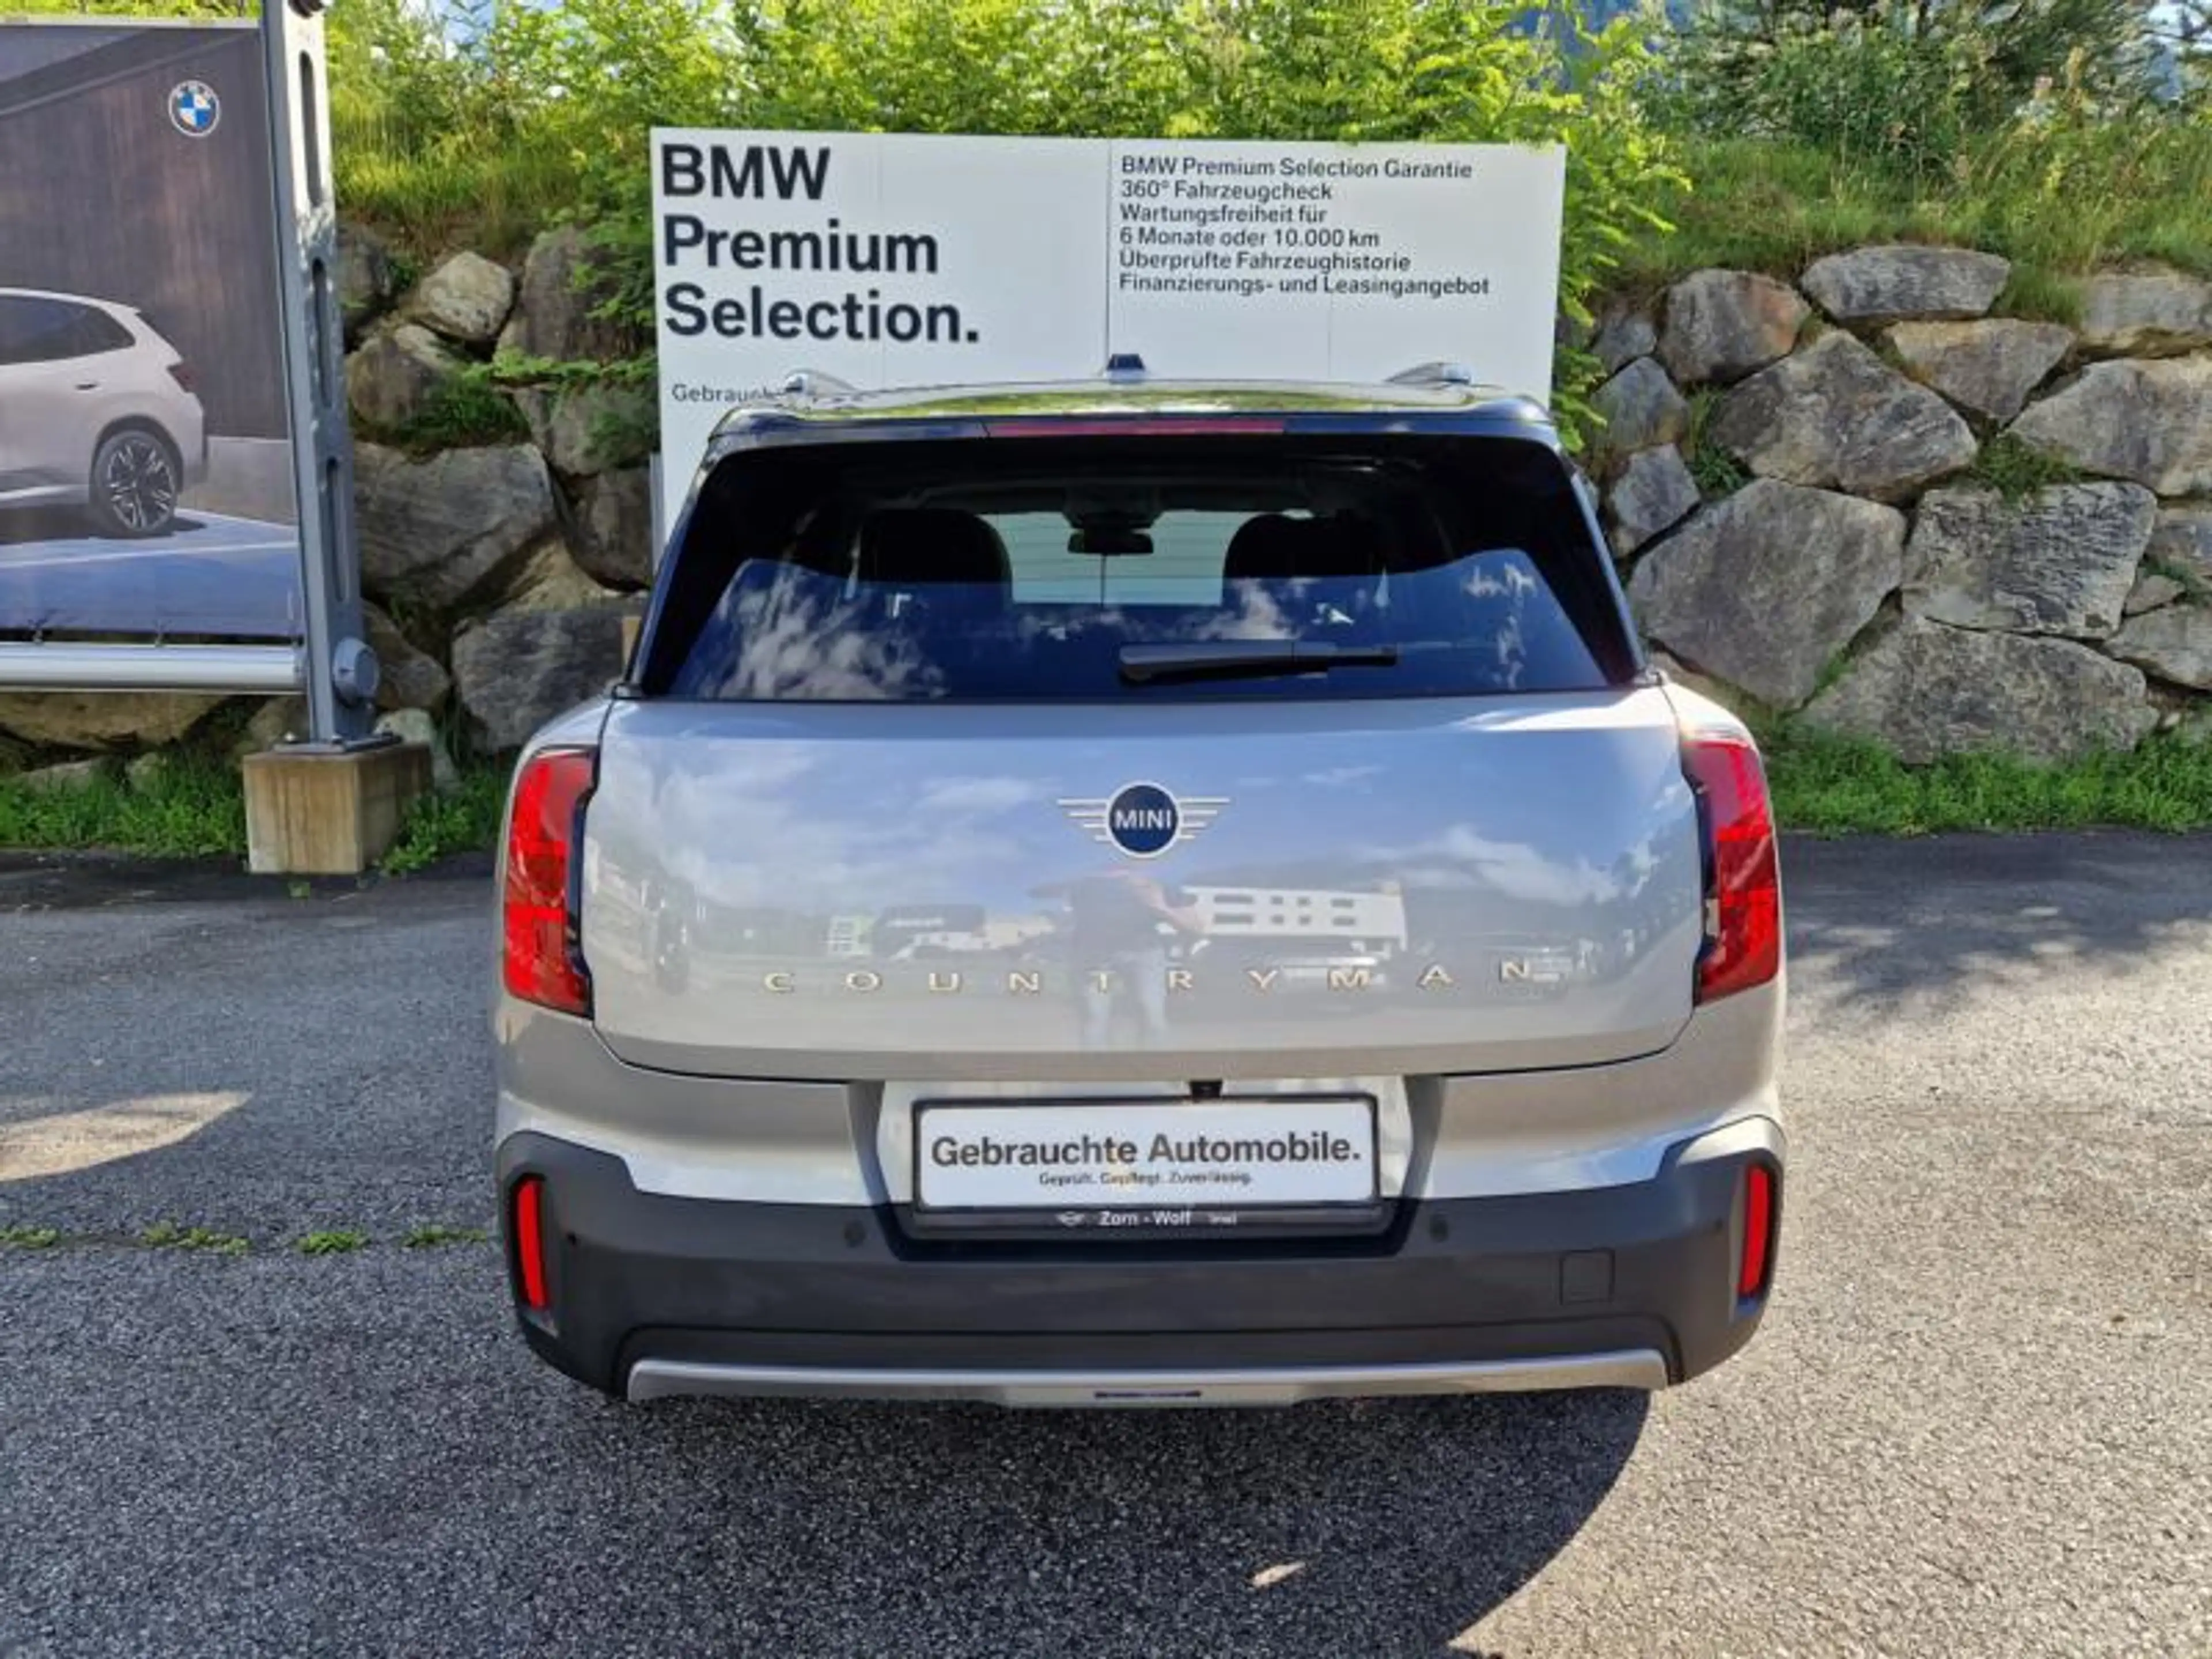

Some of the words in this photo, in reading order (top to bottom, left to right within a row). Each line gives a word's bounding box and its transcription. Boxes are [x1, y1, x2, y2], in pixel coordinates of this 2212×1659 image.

[661, 143, 831, 201] BMW
[1122, 156, 1178, 175] BMW
[1183, 157, 1275, 176] Premium
[1280, 157, 1379, 178] Selection
[1384, 158, 1473, 179] Garantie
[1122, 179, 1169, 198] 360°
[1175, 179, 1332, 204] Fahrzeugcheck
[1120, 203, 1293, 226] Wartungsfreiheit
[1298, 204, 1327, 224] für
[663, 213, 938, 275] Premium
[1120, 226, 1132, 244] 6
[1138, 226, 1215, 246] Monate
[1220, 229, 1267, 247] oder
[1275, 229, 1344, 247] 10.000
[1349, 229, 1380, 247] km
[1119, 248, 1232, 271] Überprüfte
[1236, 251, 1411, 274] Fahrzeughistorie
[1119, 272, 1273, 297] Finanzierungs-
[1279, 275, 1318, 293] und
[1322, 275, 1490, 297] Leasingangebot
[664, 282, 980, 344] Selection.
[1115, 809, 1172, 829] MINI
[764, 959, 1531, 994] COUNTRYMAN
[931, 1134, 1138, 1167] Gebrauchte
[1147, 1131, 1361, 1164] Automobile.
